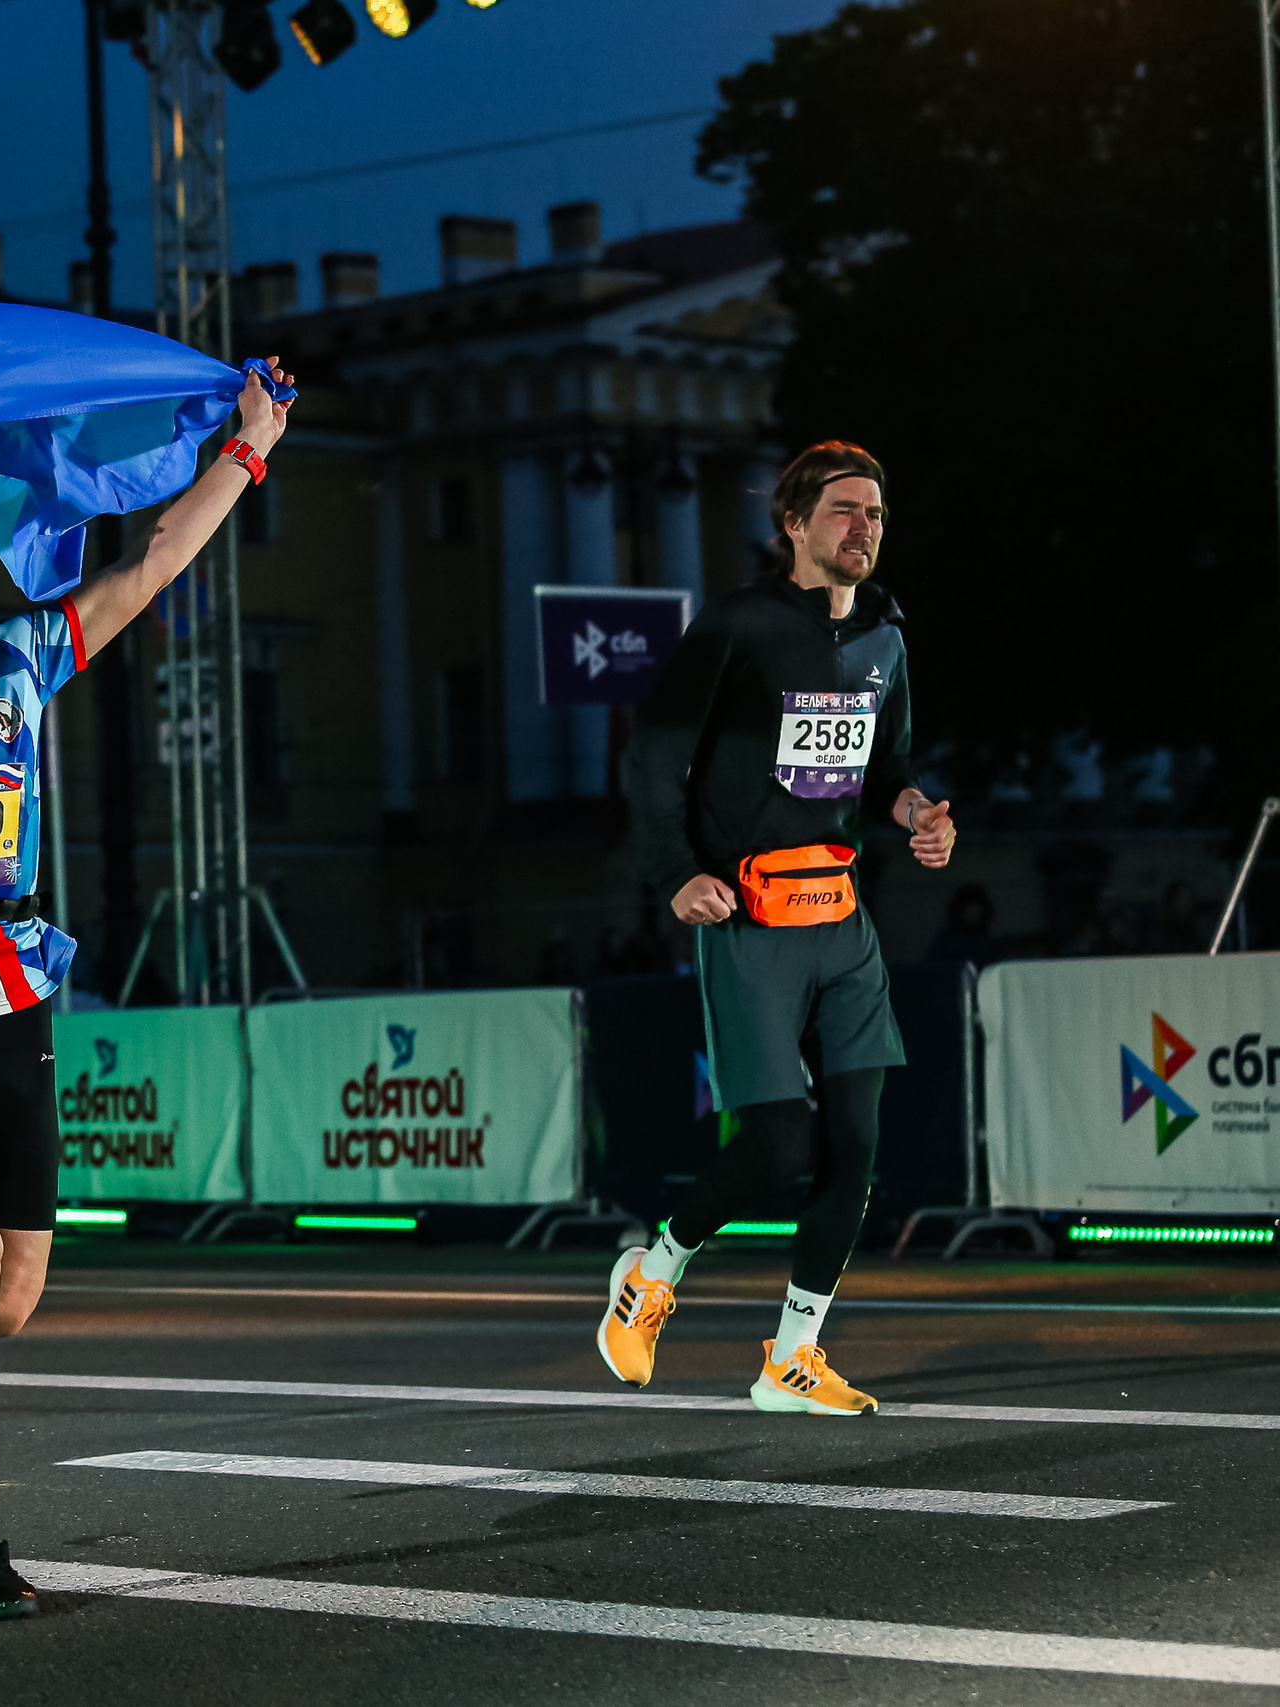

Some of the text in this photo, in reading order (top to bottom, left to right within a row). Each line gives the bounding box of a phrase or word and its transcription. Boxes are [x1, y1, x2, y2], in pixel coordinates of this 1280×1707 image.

[795, 695, 828, 708] БЕЛЫЕ
[793, 719, 866, 751] 2583
[787, 892, 832, 906] FFWD
[59, 1132, 175, 1168] сточник
[786, 1298, 816, 1316] ILA
